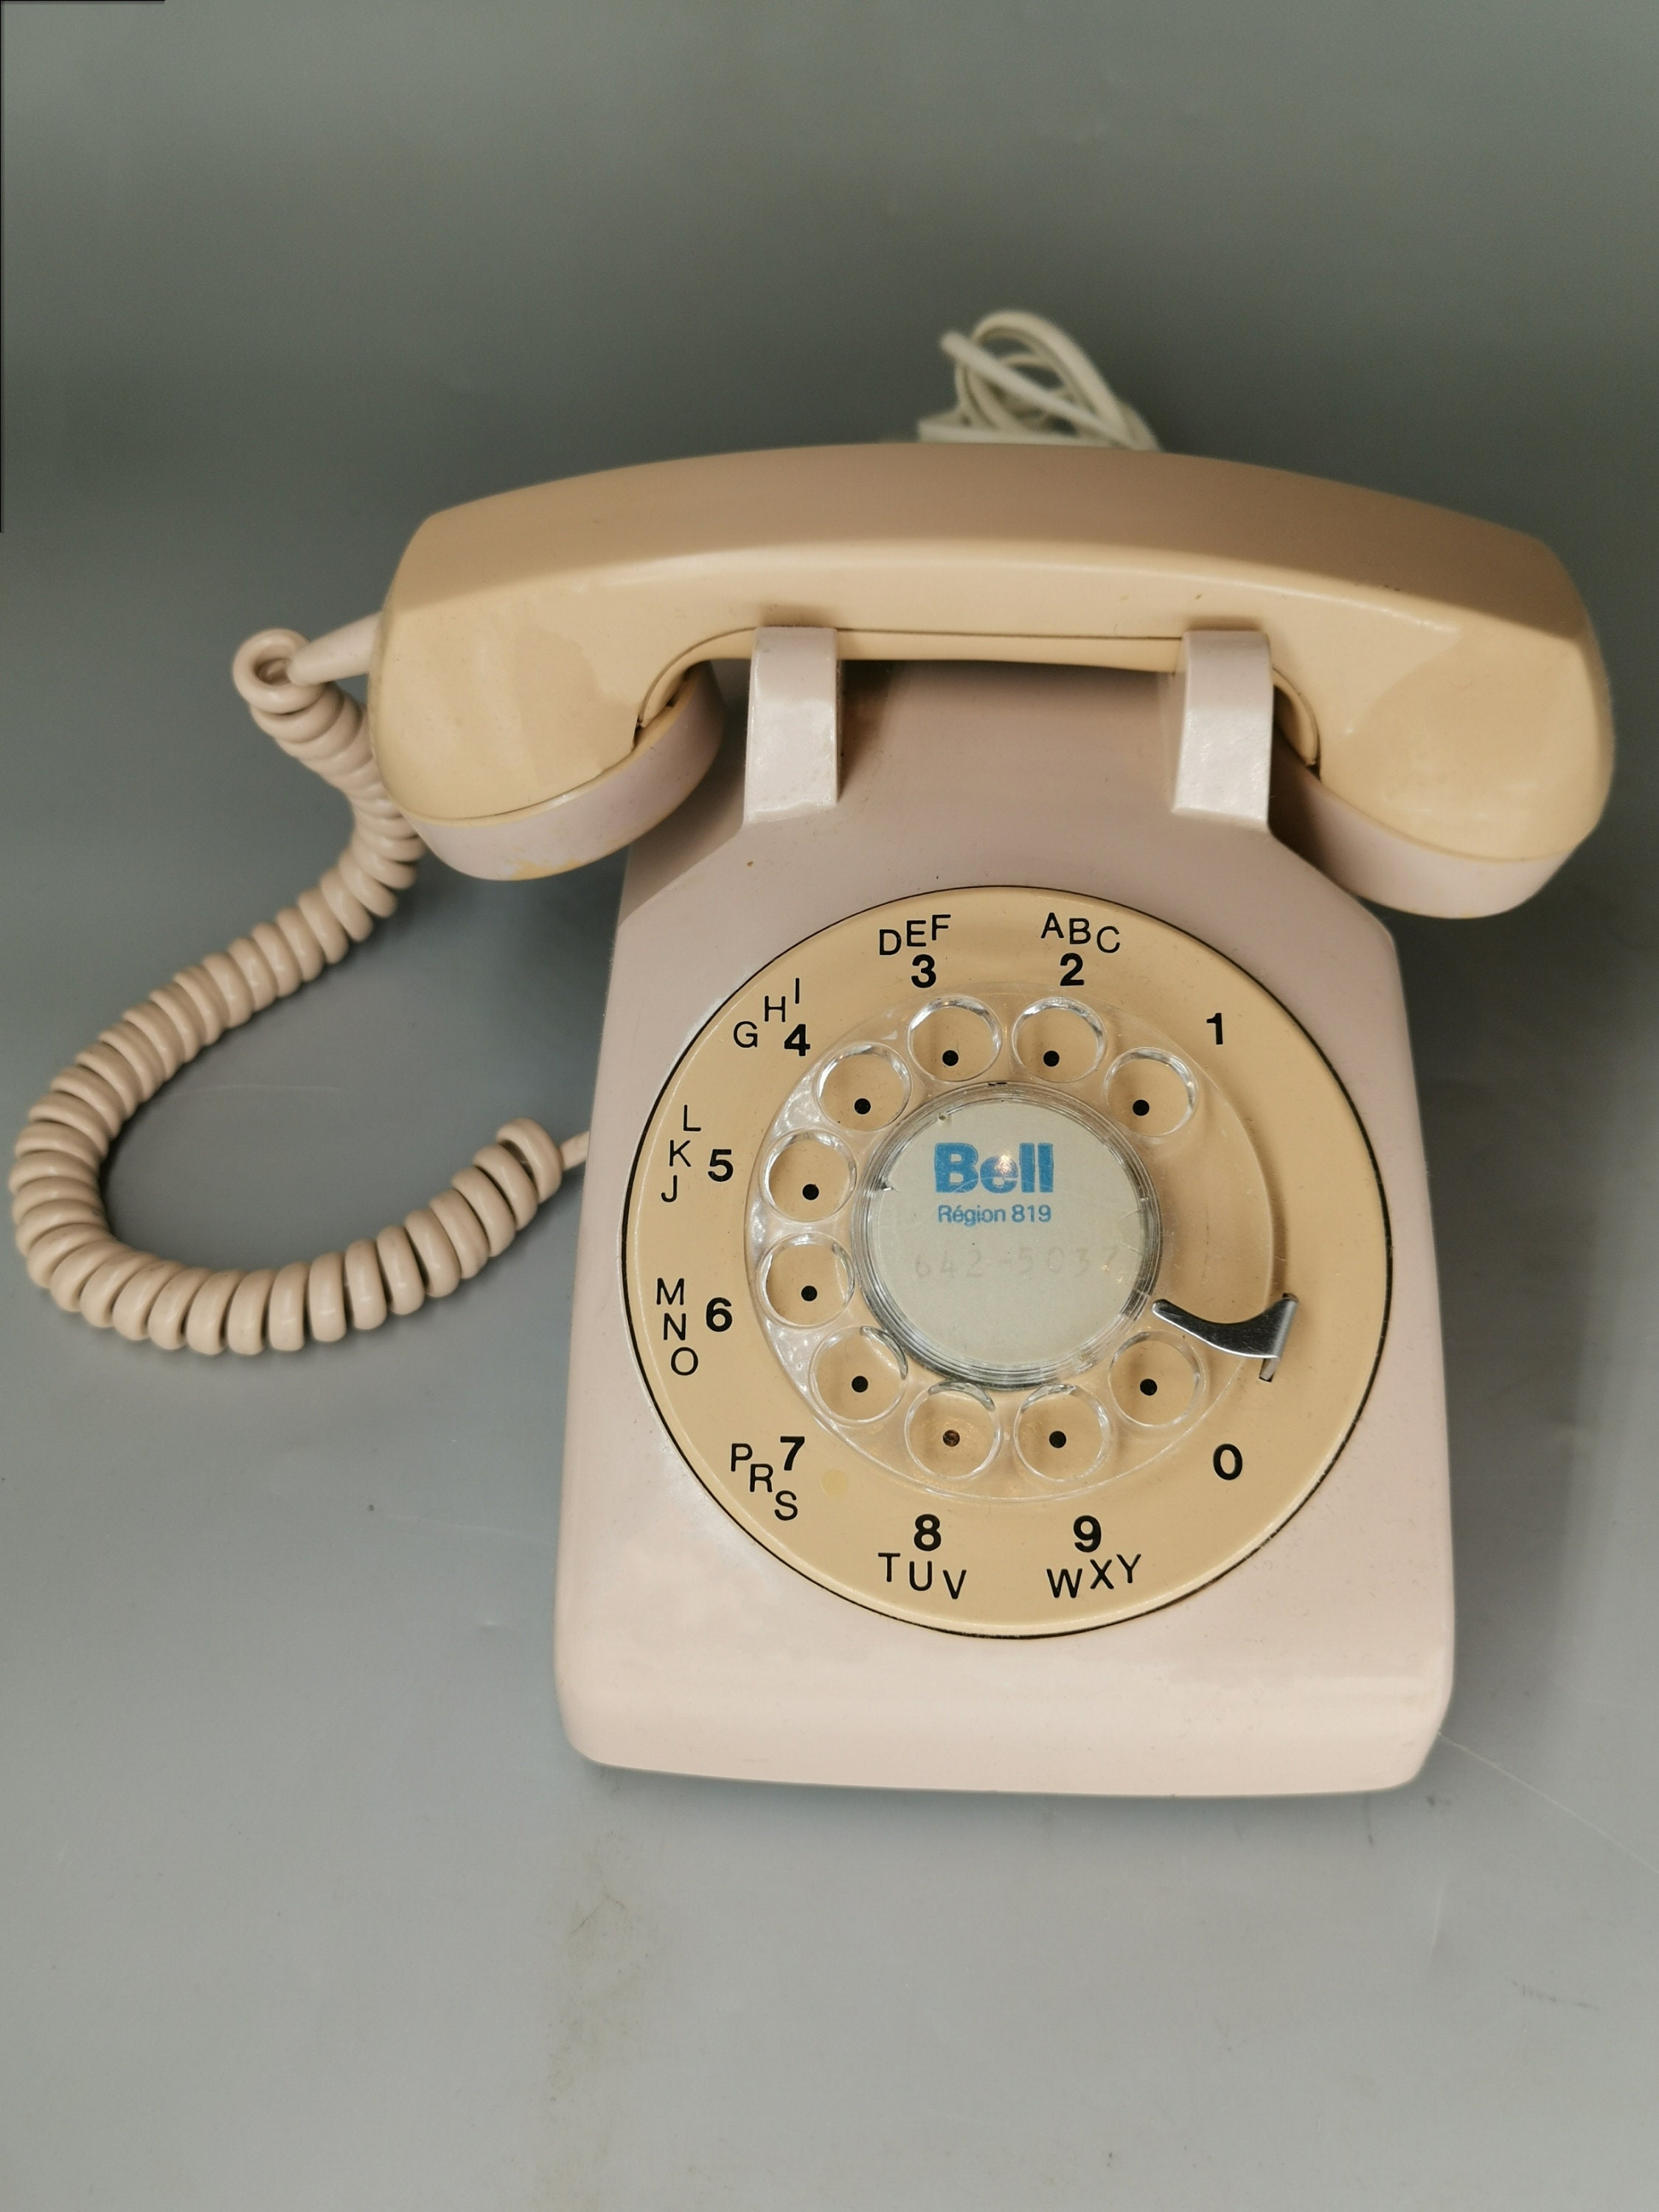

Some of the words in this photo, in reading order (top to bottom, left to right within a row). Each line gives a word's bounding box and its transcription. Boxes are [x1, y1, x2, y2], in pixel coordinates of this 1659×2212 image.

[880, 914, 950, 955] DEF
[1041, 913, 1120, 953] ABC
[911, 953, 936, 989] 3
[1060, 951, 1085, 987] 2
[733, 977, 801, 1048] GHI
[1206, 1012, 1224, 1046] 1
[784, 1023, 811, 1057] 4
[707, 1148, 734, 1183] 5
[933, 1142, 1054, 1194] Bell
[938, 1205, 1006, 1227] Région
[1011, 1204, 1052, 1223] 819
[656, 1277, 699, 1376] MNO
[706, 1297, 733, 1332] 6
[779, 1436, 805, 1471] 7
[1212, 1443, 1243, 1481] 0
[731, 1443, 799, 1521] PRS
[914, 1514, 942, 1552] 8
[1073, 1514, 1102, 1554] 9
[877, 1552, 968, 1600] TUV
[1046, 1554, 1141, 1599] WXY
